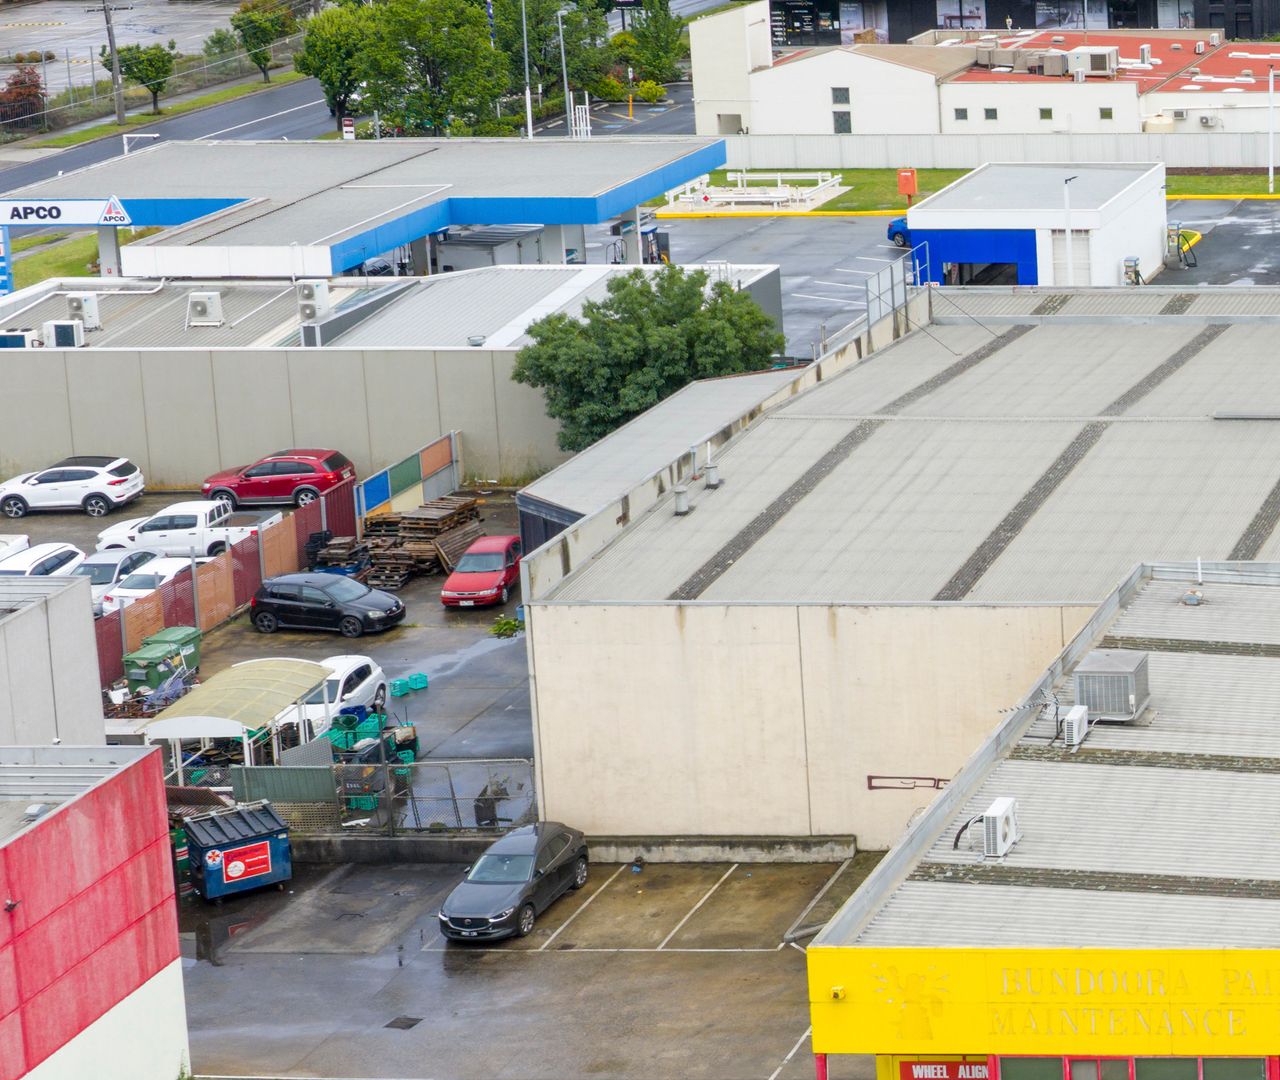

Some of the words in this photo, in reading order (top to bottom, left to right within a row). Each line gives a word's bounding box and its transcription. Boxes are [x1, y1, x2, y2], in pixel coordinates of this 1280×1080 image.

[10, 206, 61, 220] APCO
[1001, 967, 1190, 996] BUNDOORA
[989, 1007, 1247, 1036] MAINTENANCE
[912, 1065, 949, 1079] WHEEL
